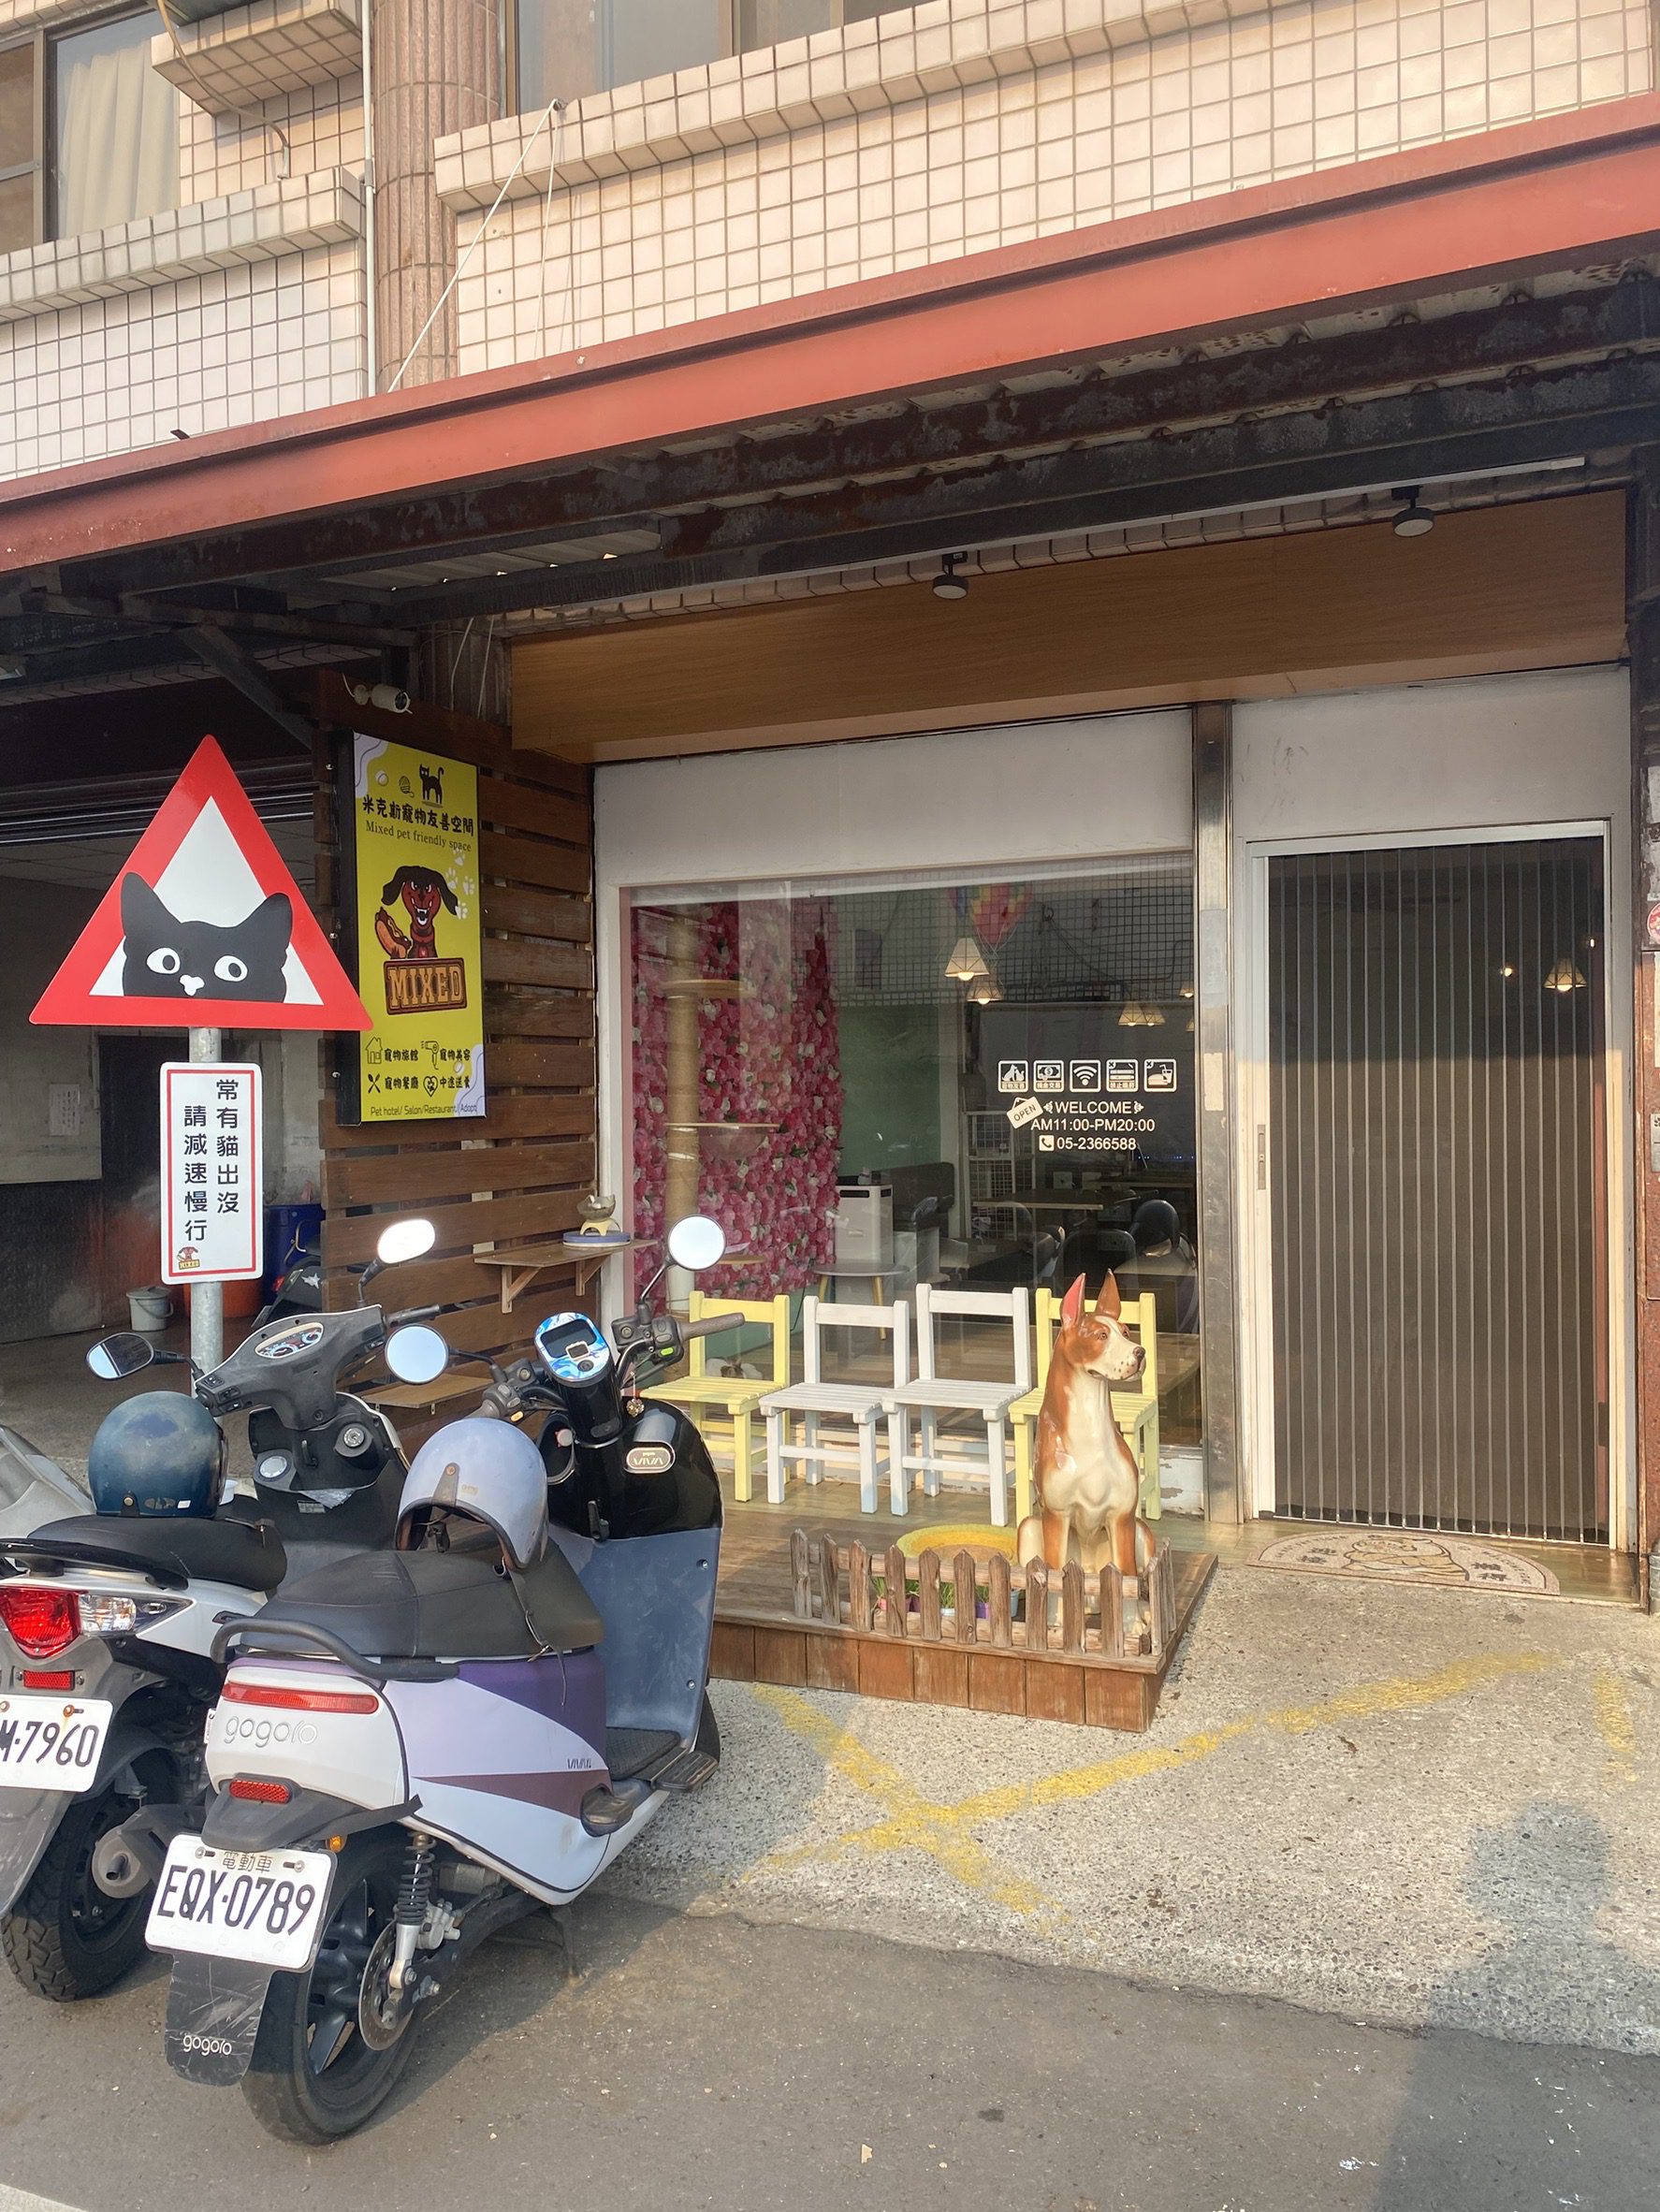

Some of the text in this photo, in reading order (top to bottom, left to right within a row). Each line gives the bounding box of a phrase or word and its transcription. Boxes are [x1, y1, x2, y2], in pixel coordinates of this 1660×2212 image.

[363, 794, 473, 837] 米克斯寵物友善空間
[366, 821, 472, 852] Mixed pet friendly space
[388, 965, 463, 1008] MIXED
[371, 1106, 383, 1116] Pet
[1013, 1104, 1037, 1122] OPEN
[1056, 1100, 1132, 1114] WELCOME
[1030, 1118, 1156, 1132] AM11:00-PM20:00
[216, 1079, 240, 1214] 常有貓出沒
[1056, 1137, 1137, 1150] 05-2366588
[183, 1104, 208, 1242] 請減速慢行
[224, 1715, 318, 1749] gogoro
[222, 1850, 273, 1874] 電動車
[182, 2034, 233, 2057] gogoro
